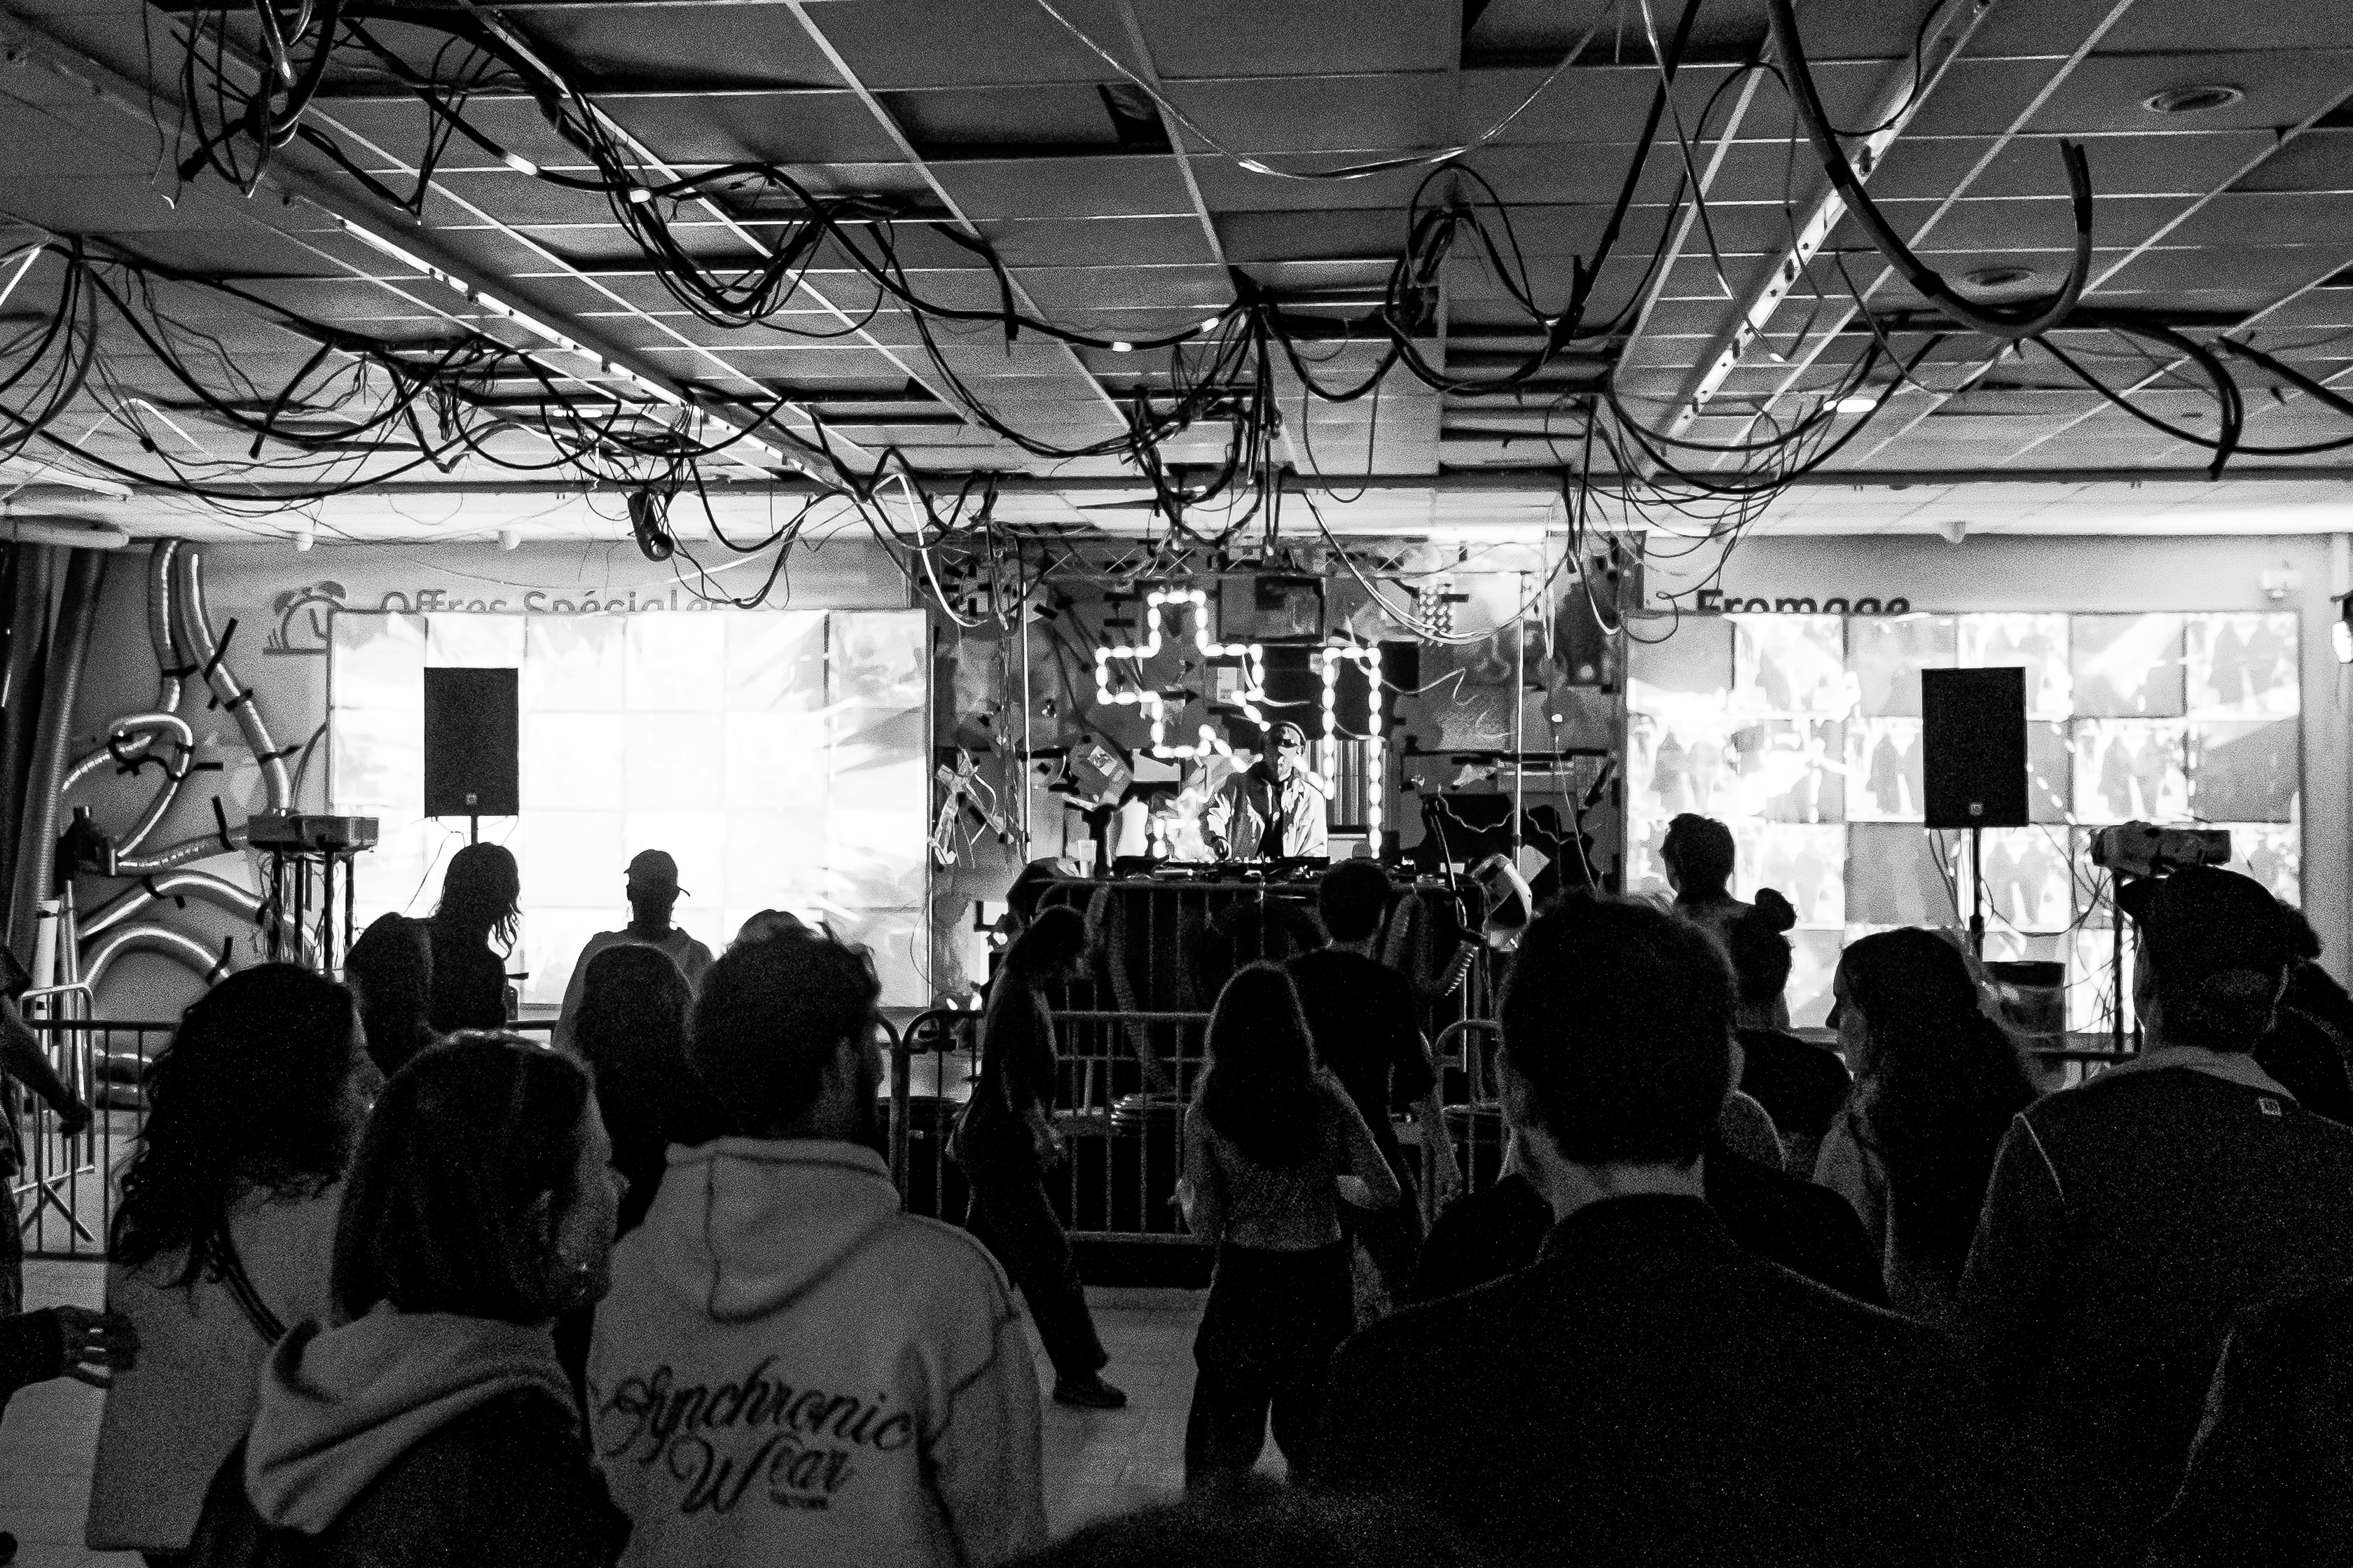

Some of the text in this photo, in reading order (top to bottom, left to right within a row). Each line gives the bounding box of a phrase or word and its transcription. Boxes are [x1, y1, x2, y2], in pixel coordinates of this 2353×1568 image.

[523, 588, 719, 612] Séciale
[598, 1354, 913, 1466] Synchronic
[667, 1431, 855, 1513] Wear
